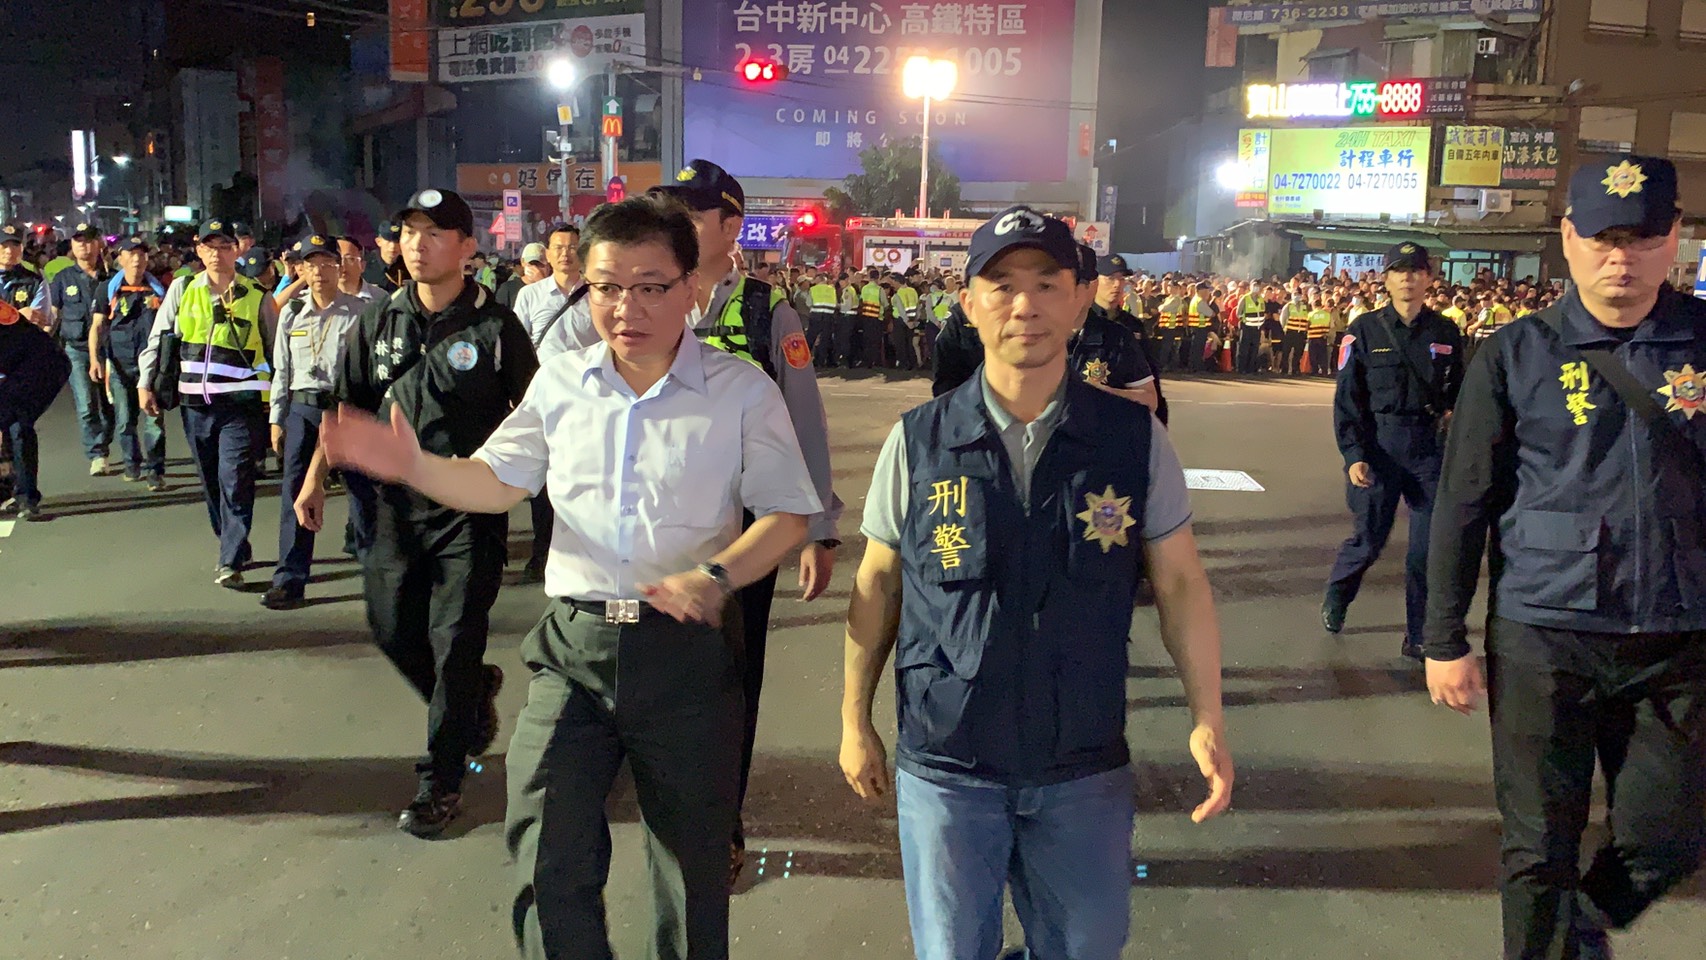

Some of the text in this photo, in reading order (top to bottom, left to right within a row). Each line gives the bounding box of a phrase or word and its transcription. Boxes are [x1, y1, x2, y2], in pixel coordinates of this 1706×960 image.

[733, 2, 1026, 35] 台中新中心 高鐵特區
[1271, 6, 1349, 20] 736-2233
[1351, 82, 1421, 114] 755-8888
[776, 108, 967, 125] COMING SOON
[1336, 131, 1417, 148] 24H TAXI
[1340, 149, 1416, 169] 計程車行
[1503, 145, 1558, 166] 油漆承包
[1274, 173, 1418, 189] 04-7270022 04-7270055
[1558, 361, 1597, 426] 刑警
[928, 475, 972, 570] 刑警
